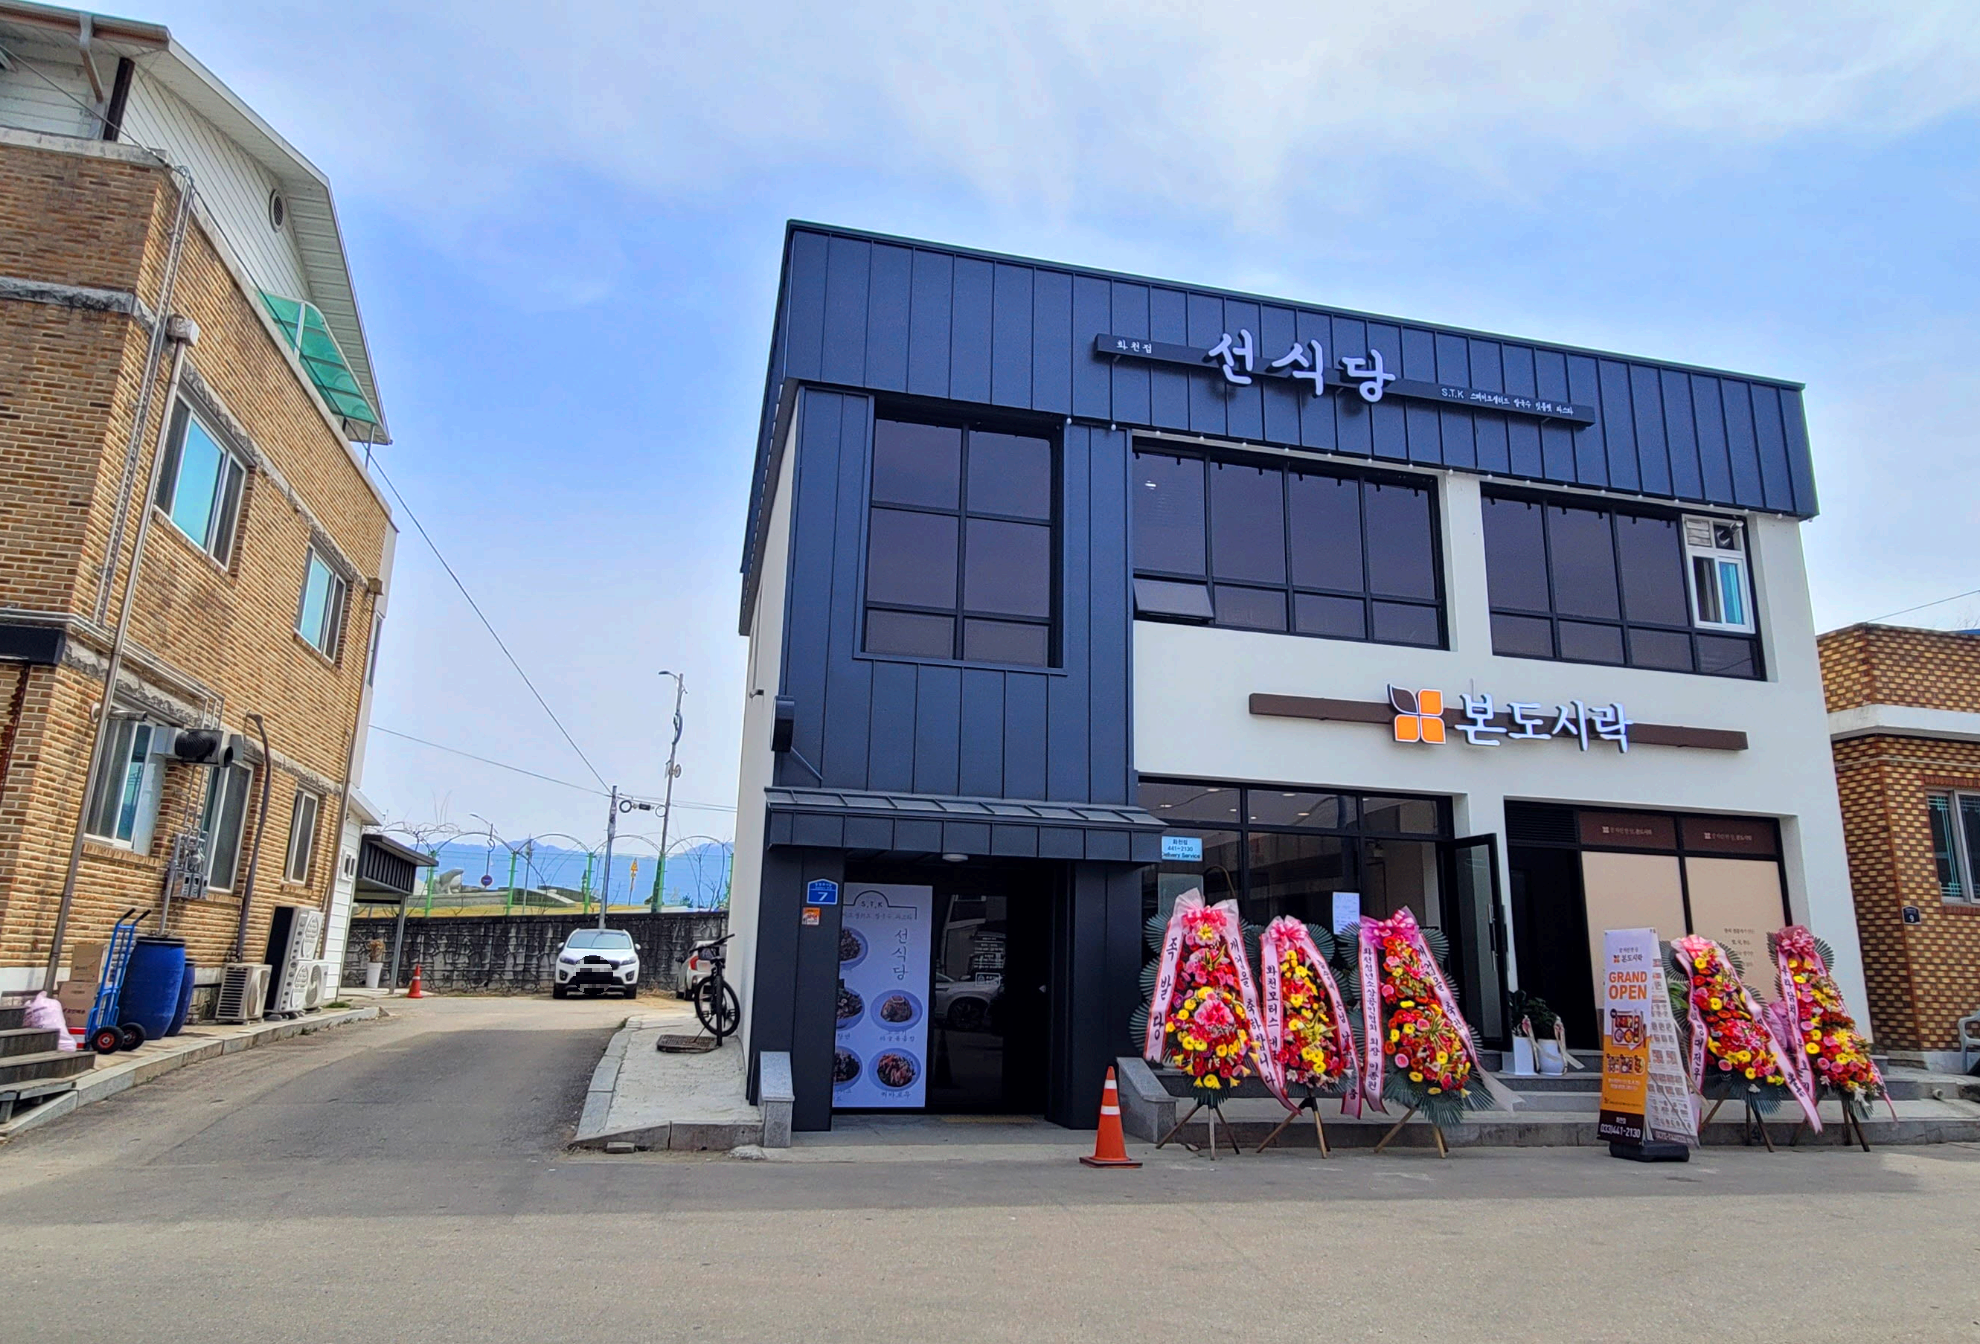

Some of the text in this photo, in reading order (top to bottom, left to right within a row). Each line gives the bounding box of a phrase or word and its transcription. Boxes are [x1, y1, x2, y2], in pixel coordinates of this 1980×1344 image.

[1208, 329, 1396, 402] 선식당
[1441, 388, 1464, 399] S.T.K
[1454, 692, 1634, 753] 본도시락
[817, 891, 829, 902] 7
[891, 928, 909, 981] 선식당
[1608, 971, 1647, 983] GRAND
[1608, 984, 1647, 999] OPEN
[1600, 1123, 1641, 1138] 033)441-2130
